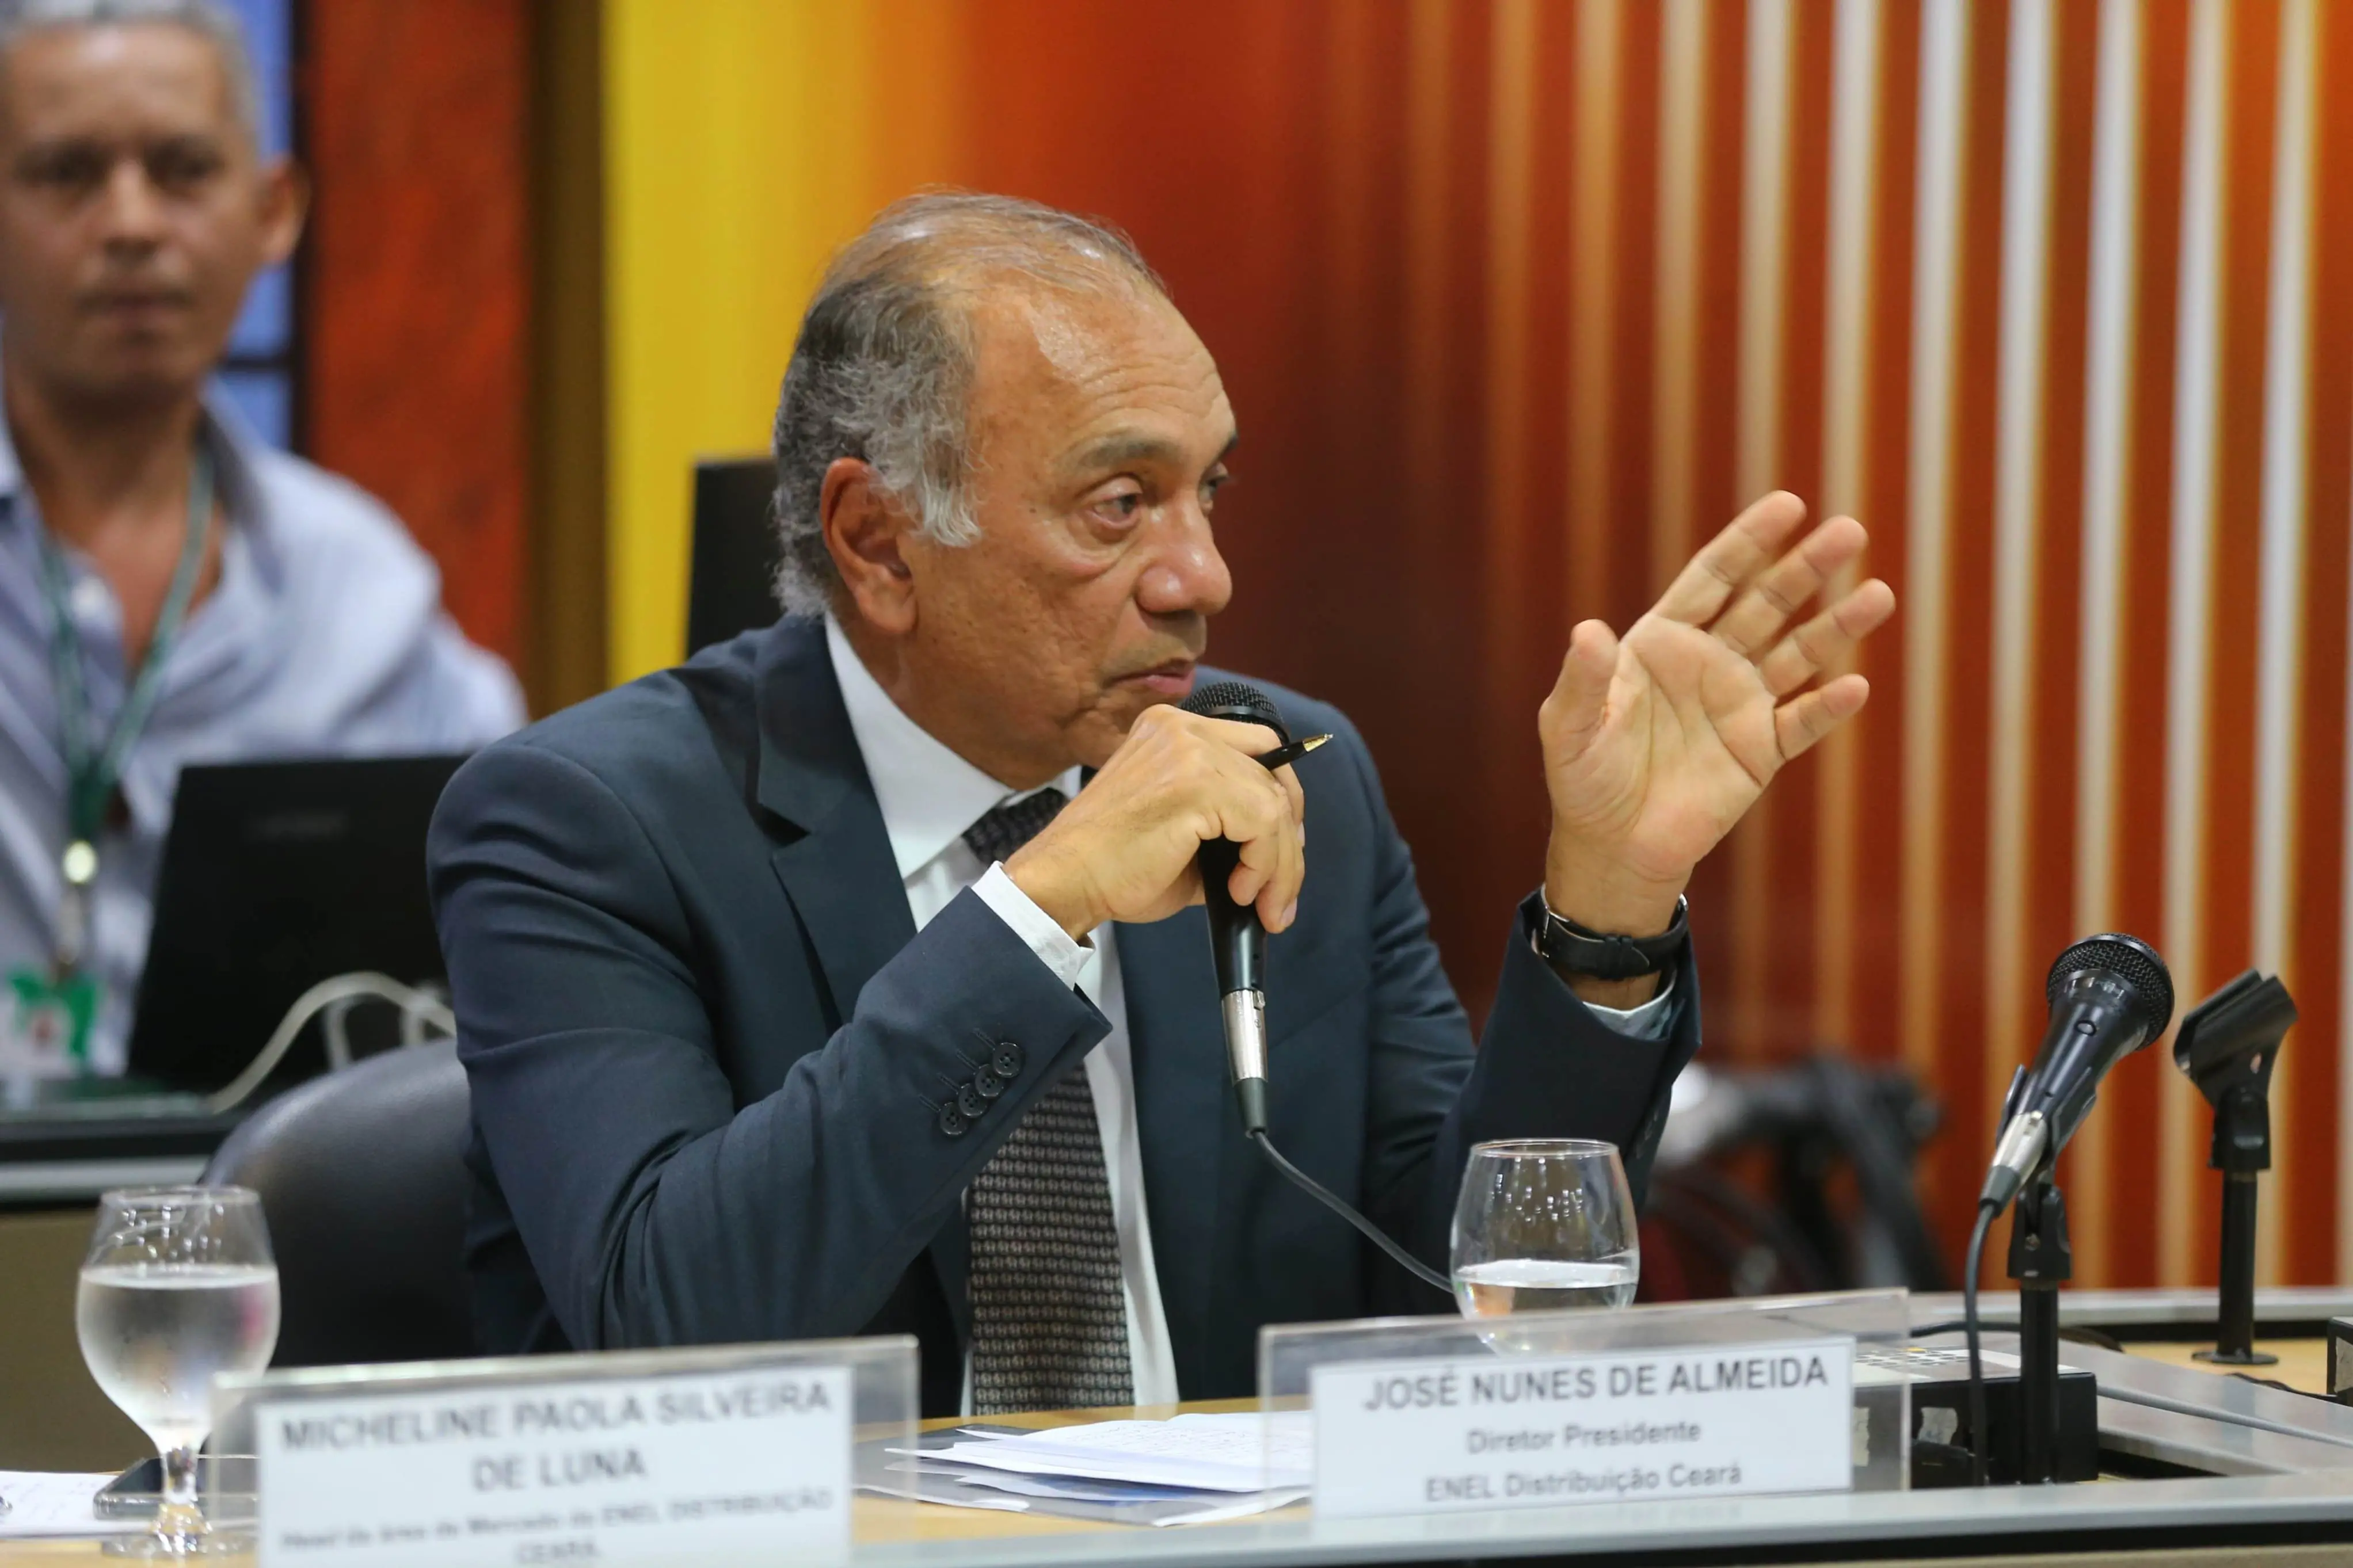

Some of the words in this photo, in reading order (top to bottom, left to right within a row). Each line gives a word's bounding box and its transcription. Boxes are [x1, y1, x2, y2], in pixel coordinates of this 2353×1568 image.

[1364, 1365, 1459, 1410] JOSÉ
[1471, 1368, 1597, 1404] NUNES
[1609, 1365, 1657, 1397] DE
[1669, 1356, 1828, 1394] ALMEIDA
[283, 1406, 497, 1448] MICHELINE
[513, 1395, 646, 1436] PAOLA
[657, 1382, 831, 1424] SILVEIRA
[1467, 1428, 1554, 1454] Diretor
[1563, 1422, 1701, 1448] Presidente
[472, 1455, 524, 1491] DE
[539, 1448, 646, 1487] LUNA
[1426, 1475, 1495, 1501] ENEL
[1505, 1469, 1661, 1497] Distribuição
[1669, 1459, 1742, 1487] Ceará
